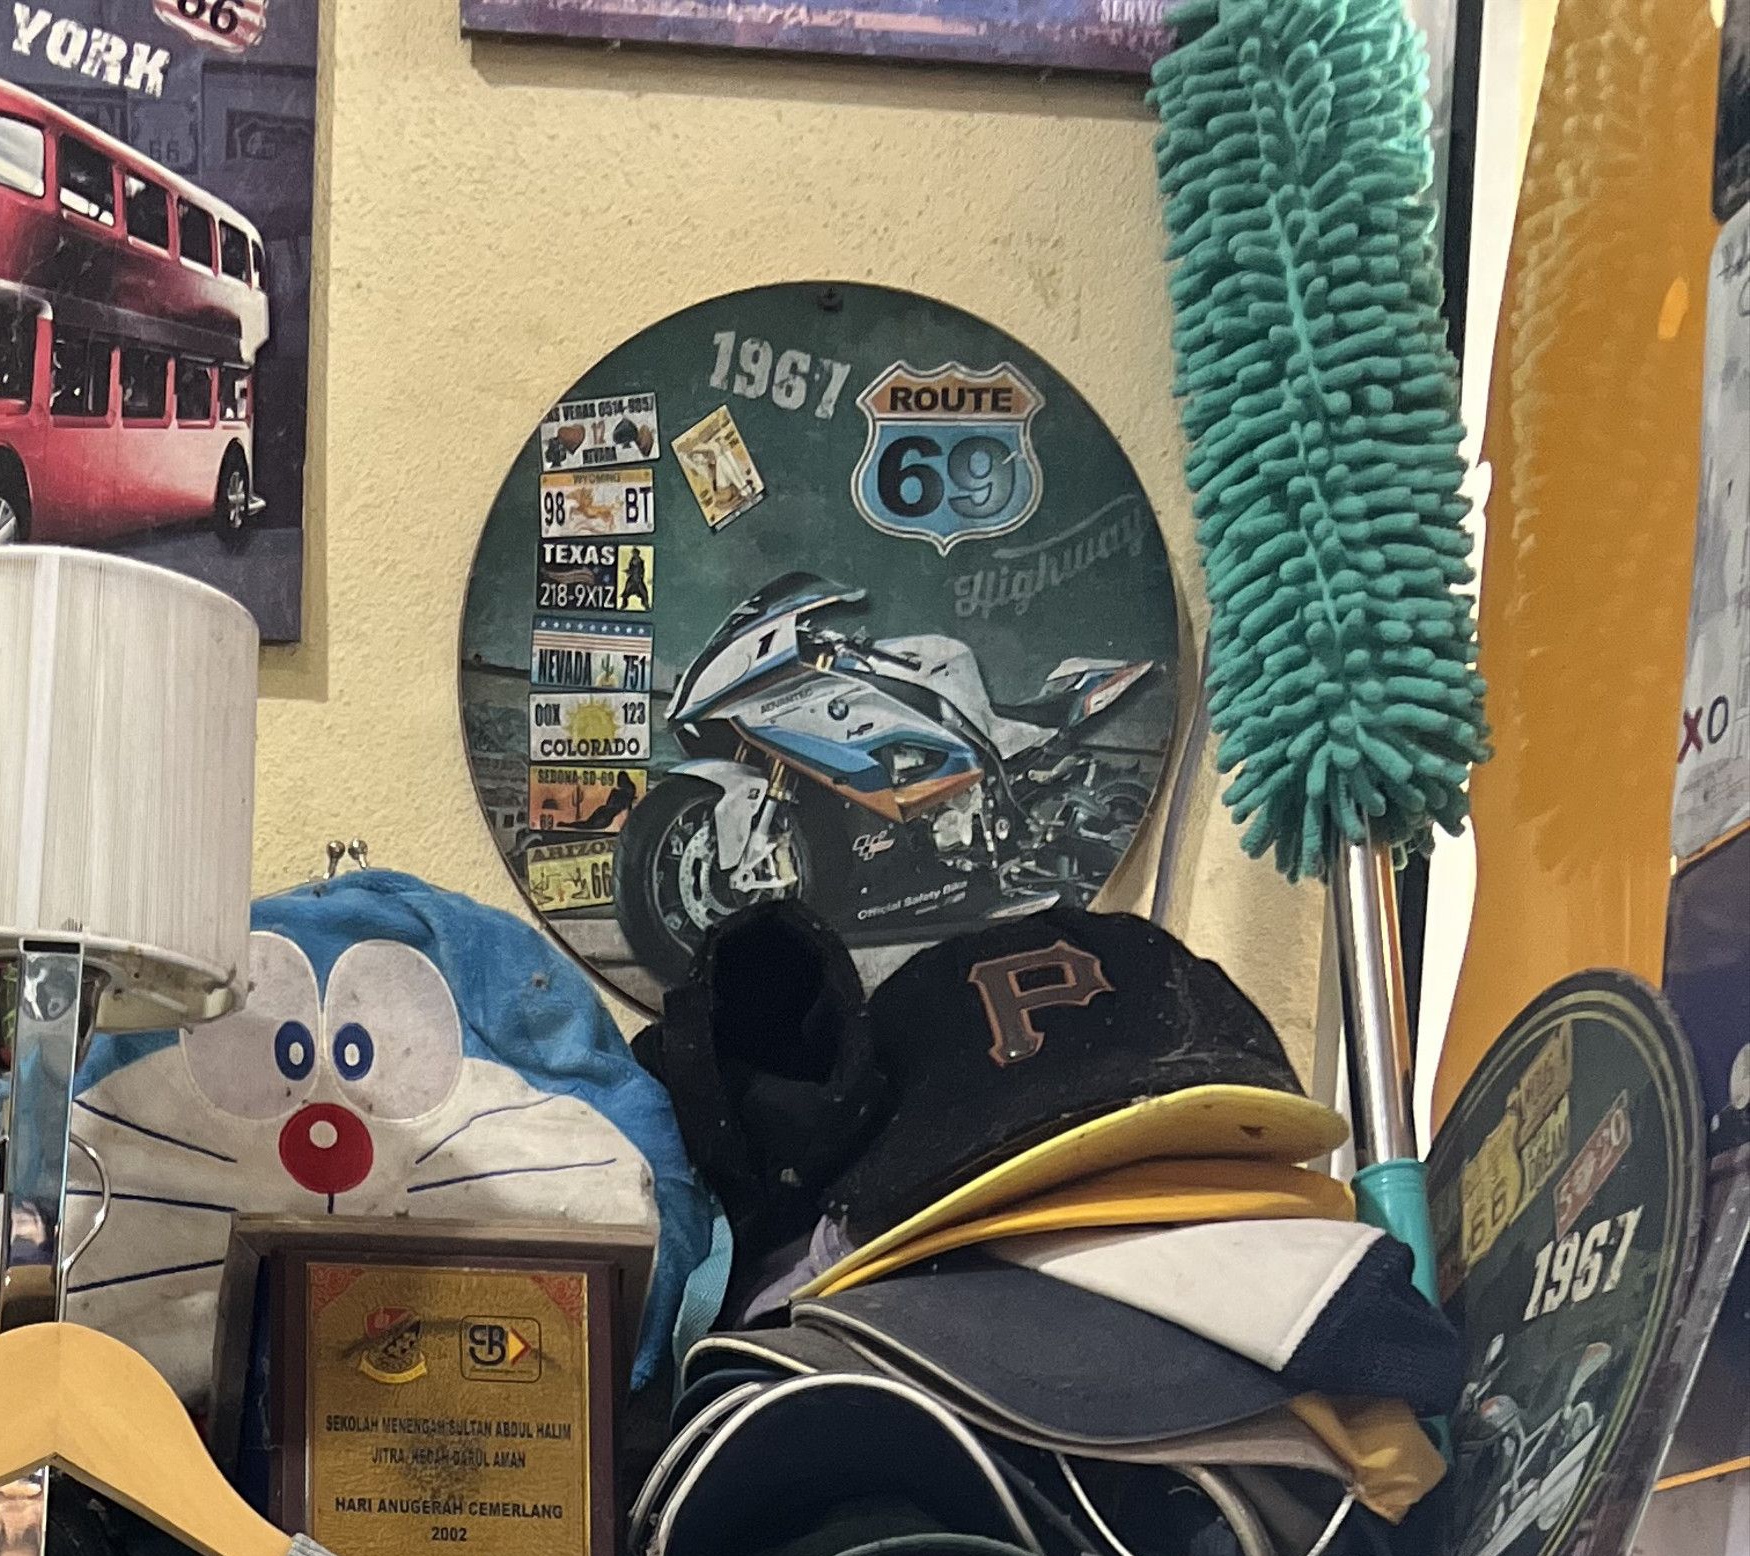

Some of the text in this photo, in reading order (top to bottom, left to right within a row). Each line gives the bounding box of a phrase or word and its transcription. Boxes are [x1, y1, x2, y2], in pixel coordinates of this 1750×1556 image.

[11, 3, 172, 98] YORK
[709, 331, 851, 420] 1967
[889, 386, 1013, 413] ROUTE
[877, 435, 1017, 519] 69
[544, 491, 566, 527] 98
[625, 486, 652, 524] BT
[543, 543, 616, 566] TEXAS
[953, 507, 1148, 619] Highway
[756, 629, 778, 660] 1
[538, 648, 591, 686] NEVADA
[623, 654, 647, 690] 751
[622, 702, 646, 725] 123
[540, 738, 640, 757] COLORADO
[967, 939, 1117, 1068] P
[1523, 1205, 1644, 1322] 1967
[325, 1414, 379, 1433] SEKOLAH
[495, 1421, 534, 1440] ABDUL
[493, 1451, 526, 1469] AMAN
[335, 1497, 564, 1520] HARI ANUGERAH CEMERLANG
[431, 1526, 468, 1543] 2002
